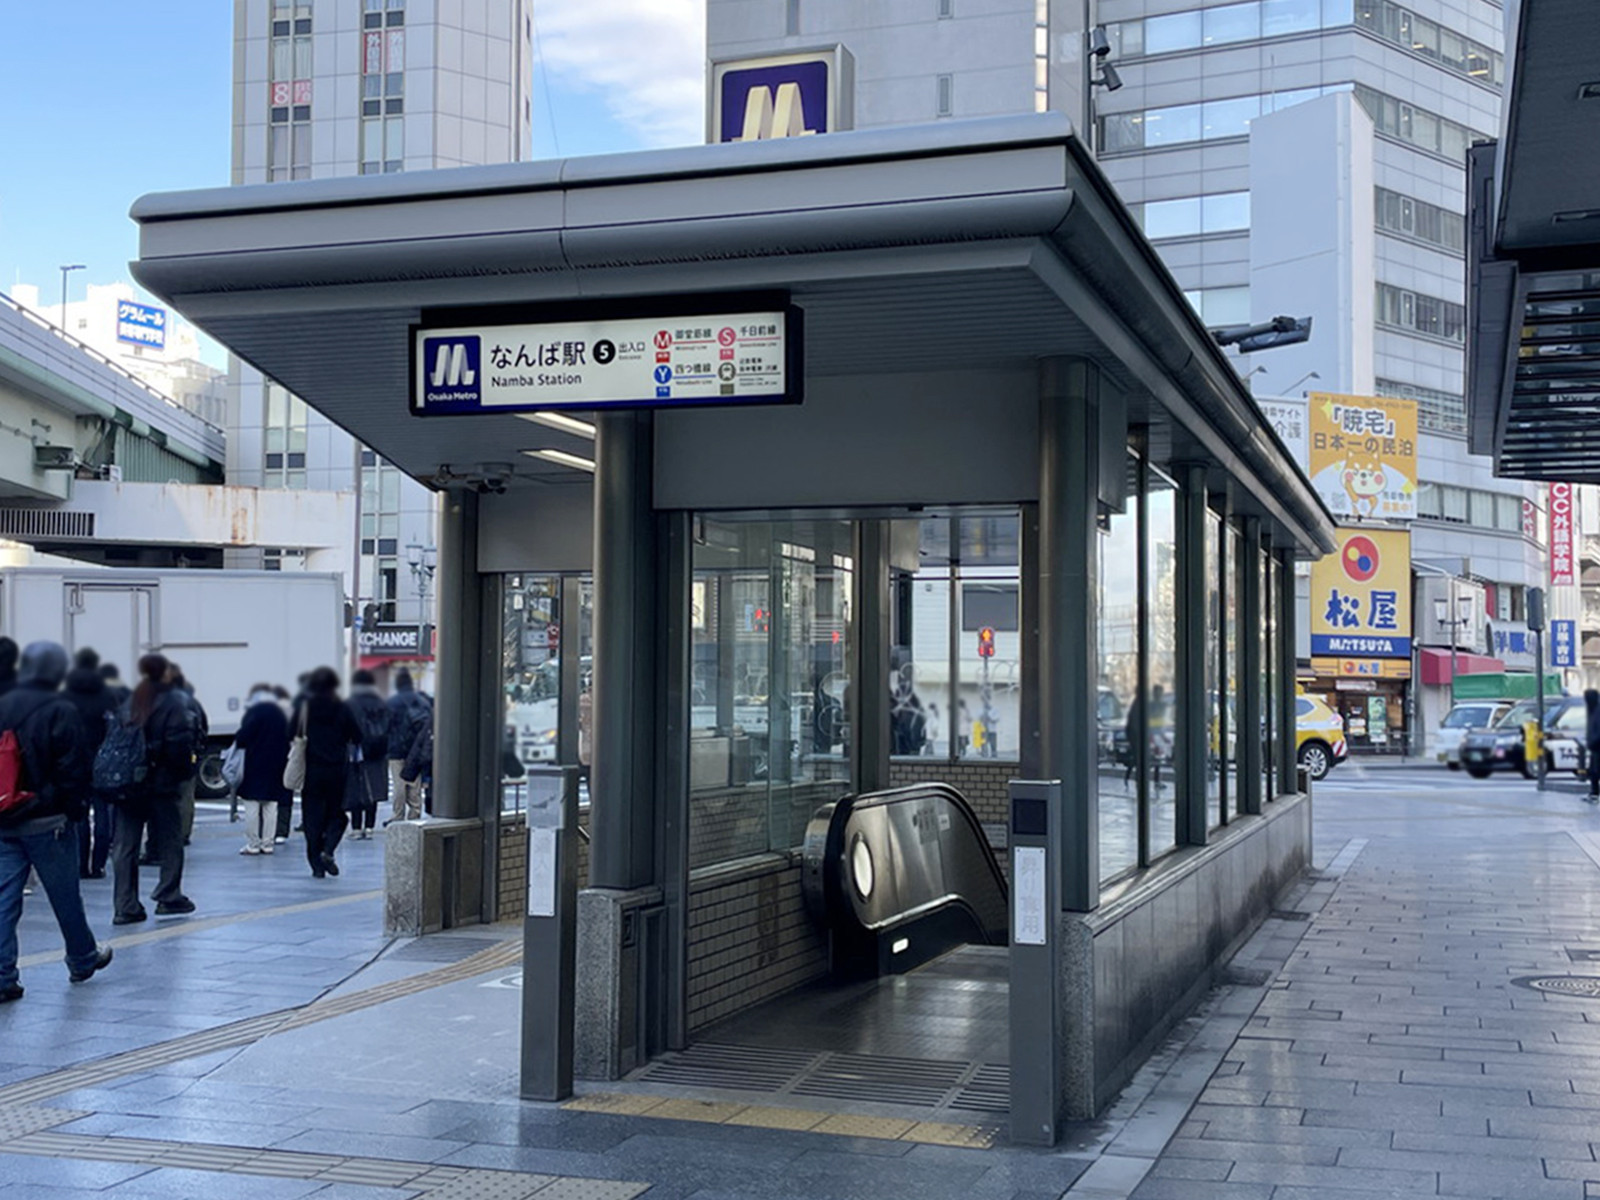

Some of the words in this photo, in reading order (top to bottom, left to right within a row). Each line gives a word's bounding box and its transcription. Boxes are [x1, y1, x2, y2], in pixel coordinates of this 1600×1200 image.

[619, 341, 645, 353] 出入口
[655, 332, 671, 348] M
[490, 341, 586, 369] なんば駅
[491, 378, 534, 387] Namba
[538, 374, 582, 385] Station
[428, 393, 453, 401] Osaka
[454, 392, 477, 400] Metro
[1314, 432, 1413, 456] 日本一の民泊
[1325, 589, 1397, 629] 松屋
[1328, 638, 1393, 652] MATSUYA
